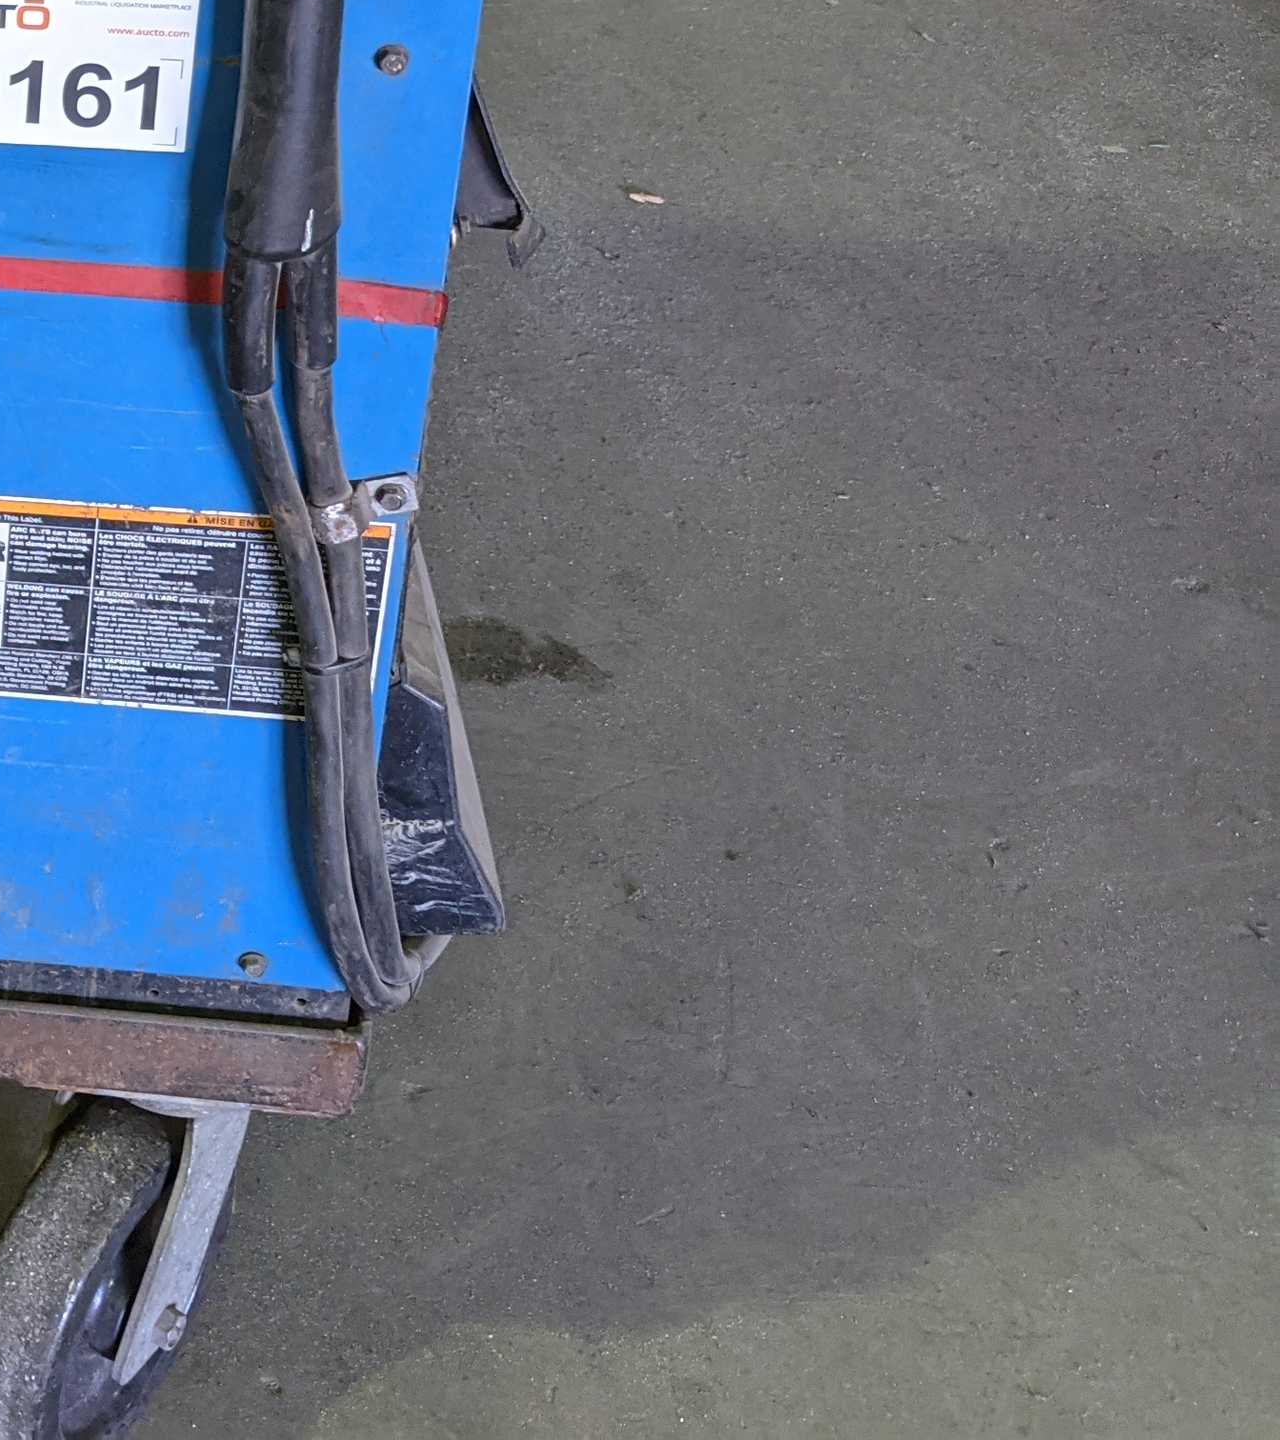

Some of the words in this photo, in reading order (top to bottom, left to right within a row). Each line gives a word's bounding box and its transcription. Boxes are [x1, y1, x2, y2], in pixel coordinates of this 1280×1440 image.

[151, 3, 192, 11] MARKETPLACE
[107, 26, 191, 38] www.aucto.com
[205, 516, 235, 526] MISE
[239, 518, 254, 527] EN
[98, 532, 113, 540] Les
[115, 533, 144, 542] CHOCS
[203, 540, 235, 549] peuvent
[6, 583, 43, 592] WELDING
[60, 587, 84, 595] cause
[104, 658, 140, 666] VAPEURS
[183, 664, 214, 672] peuvent
